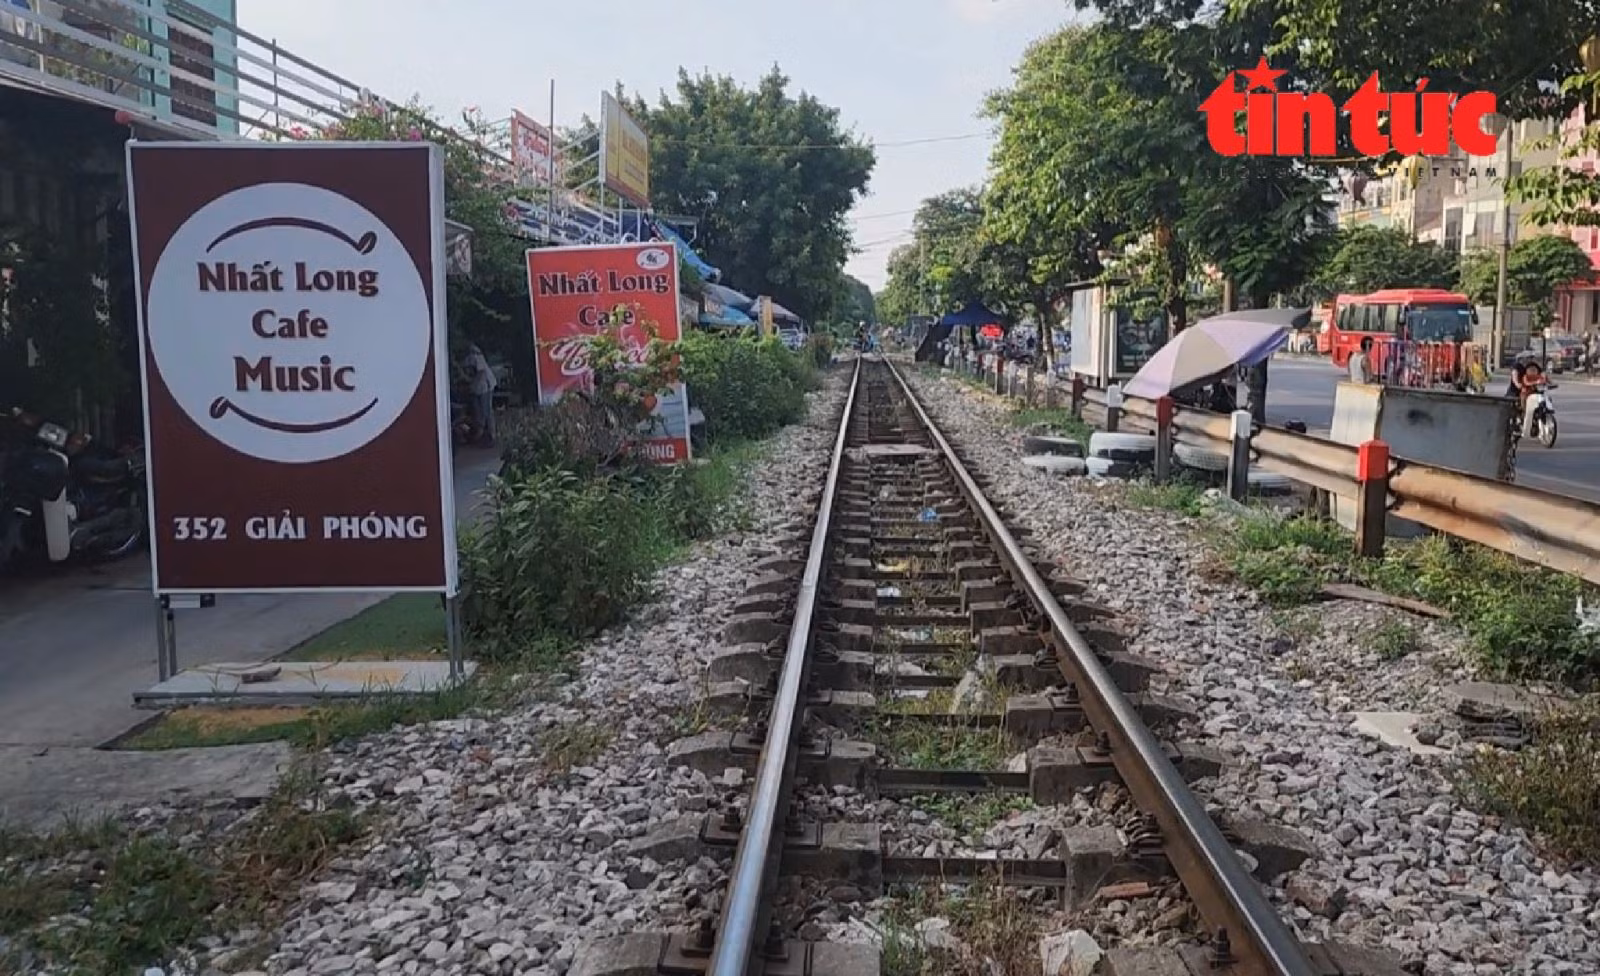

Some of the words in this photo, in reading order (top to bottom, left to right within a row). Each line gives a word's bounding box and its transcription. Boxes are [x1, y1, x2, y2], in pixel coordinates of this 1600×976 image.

[197, 261, 284, 292] Nhất
[295, 261, 379, 297] Long
[538, 270, 600, 295] Nhất
[608, 269, 669, 294] Long
[252, 308, 329, 339] Cafe
[233, 355, 356, 392] Music
[173, 517, 227, 541] 352
[245, 509, 306, 541] GIẢI
[322, 511, 428, 540] PHÓNG
